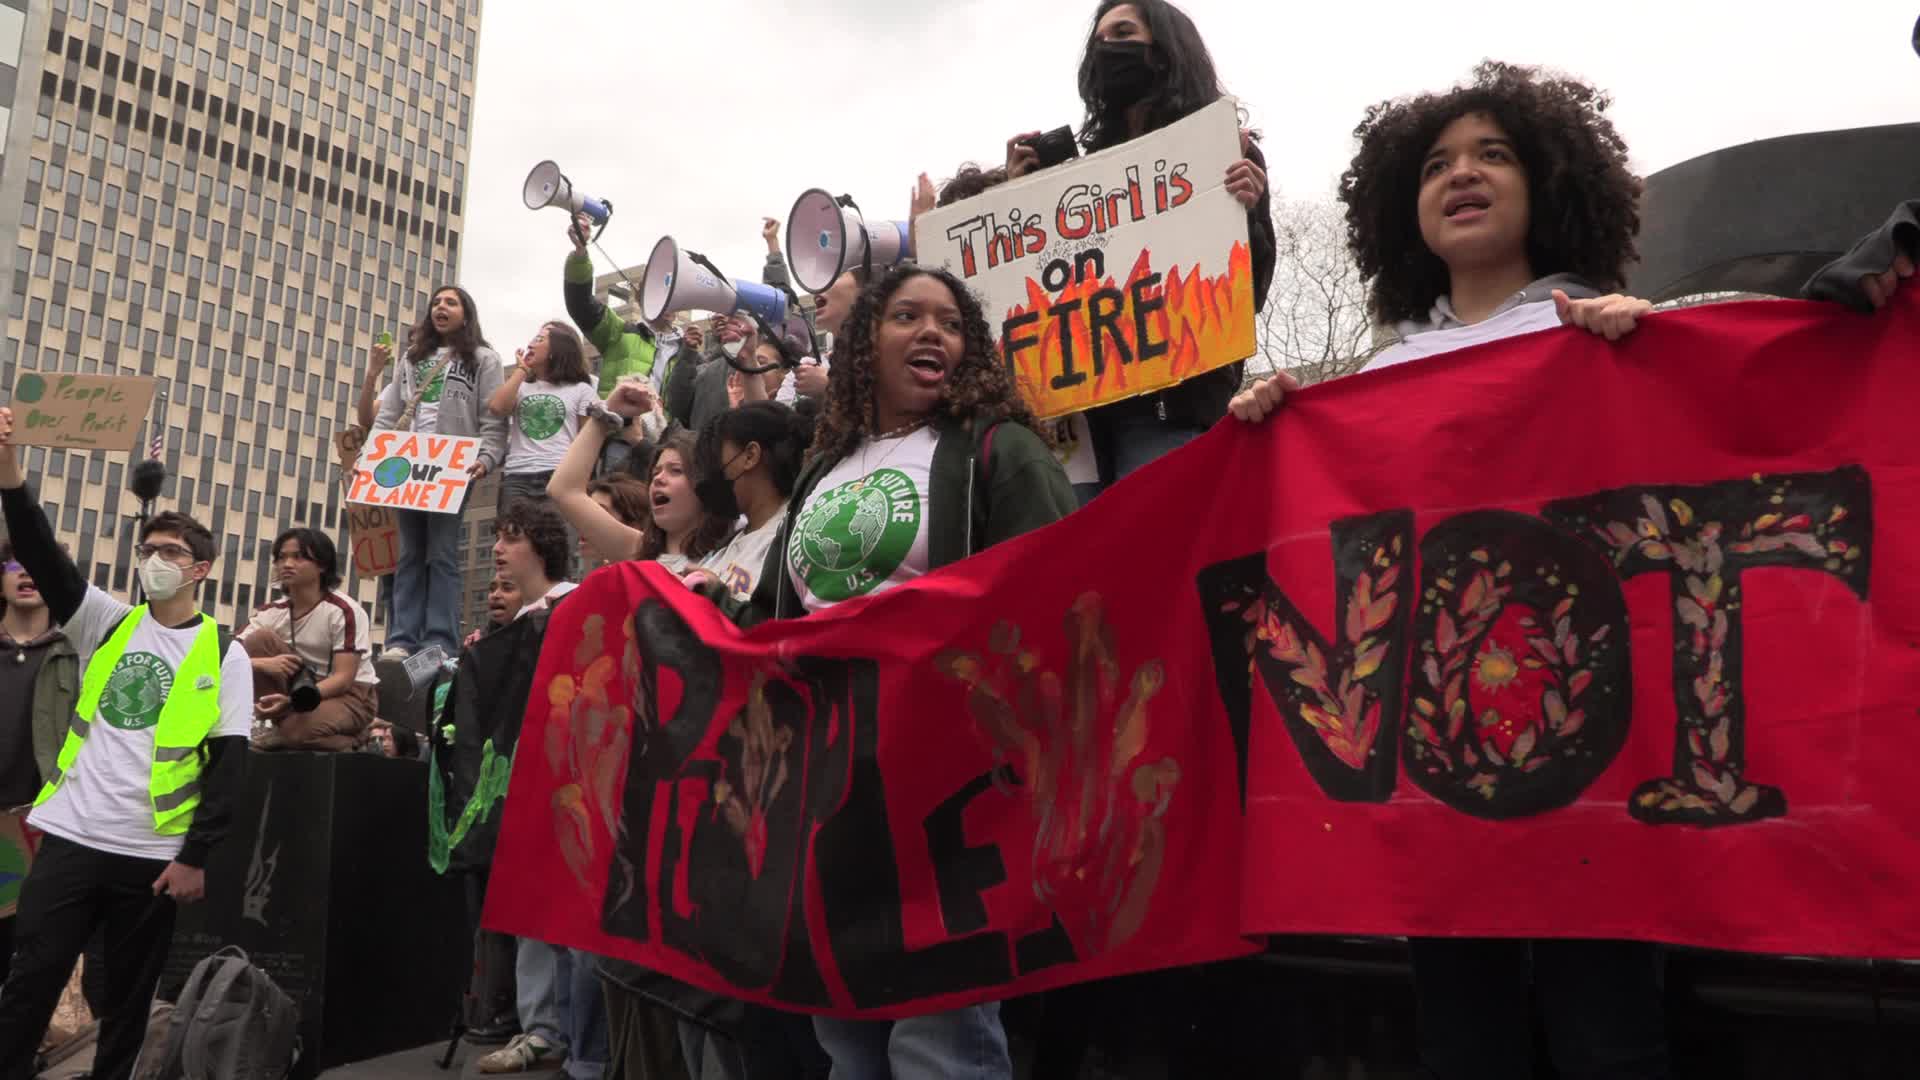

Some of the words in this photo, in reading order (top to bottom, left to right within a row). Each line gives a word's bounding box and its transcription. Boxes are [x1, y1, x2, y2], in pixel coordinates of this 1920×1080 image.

[947, 208, 1047, 279] This
[1055, 164, 1146, 241] Girl
[1154, 159, 1194, 215] is
[1041, 247, 1106, 293] on
[1002, 271, 1169, 391] FIRE
[53, 375, 124, 408] People
[26, 410, 69, 430] Over
[366, 433, 474, 470] SAVE
[348, 470, 466, 510] PLANET
[872, 472, 914, 523] FUTURE
[126, 653, 153, 667] FOR
[1195, 463, 1873, 829] NOT
[123, 716, 145, 727] U.S.
